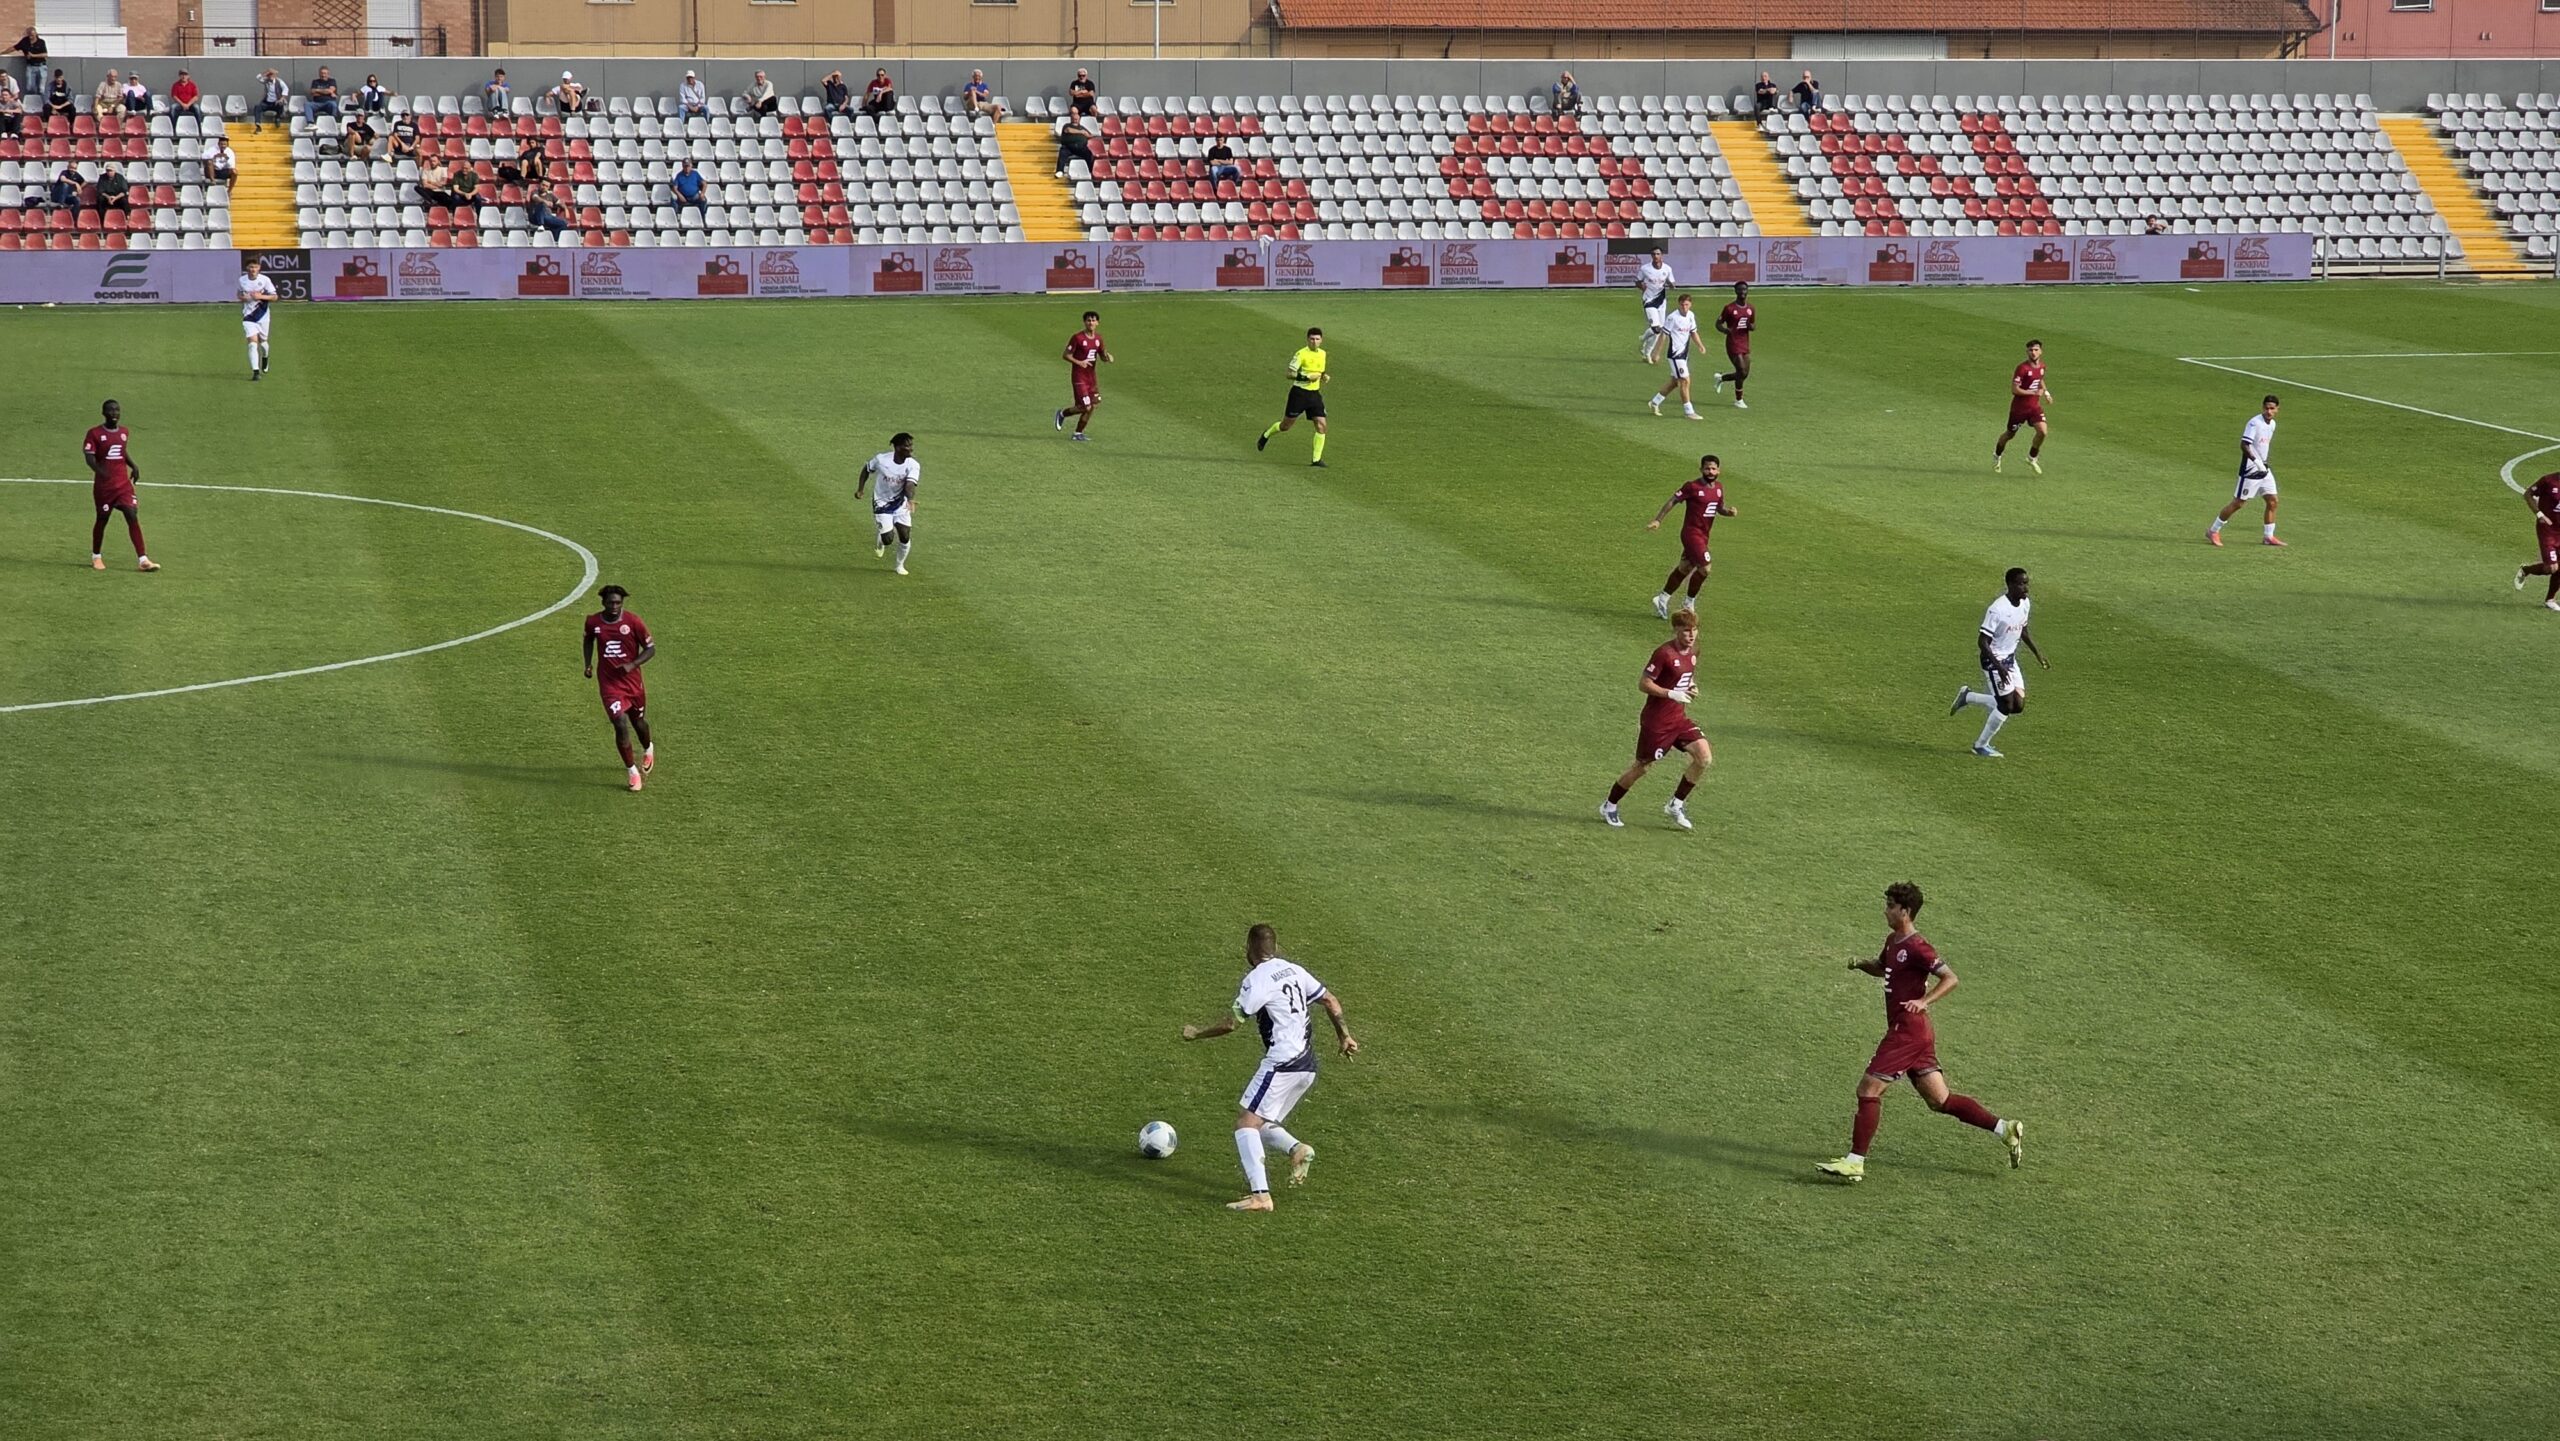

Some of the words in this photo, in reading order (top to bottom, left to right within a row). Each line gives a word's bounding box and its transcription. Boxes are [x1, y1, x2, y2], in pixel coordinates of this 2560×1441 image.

[1766, 264, 1802, 272] GENERALI
[1924, 264, 1959, 272] GENERALI
[2079, 263, 2115, 271] GENERALI
[2234, 260, 2269, 268] GENERALI
[1105, 269, 1145, 278] GENERALI
[1275, 268, 1314, 276] GENERALI
[1440, 267, 1478, 275] GENERALI
[1604, 266, 1641, 274] GENERAL
[580, 277, 622, 285] GENERALI
[759, 276, 799, 284] GENERALI
[933, 273, 973, 281] GENERALI
[399, 277, 441, 286] GENERALI
[94, 290, 159, 300] ecostream
[1654, 748, 1664, 761] 6
[1282, 980, 1305, 1014] 21
